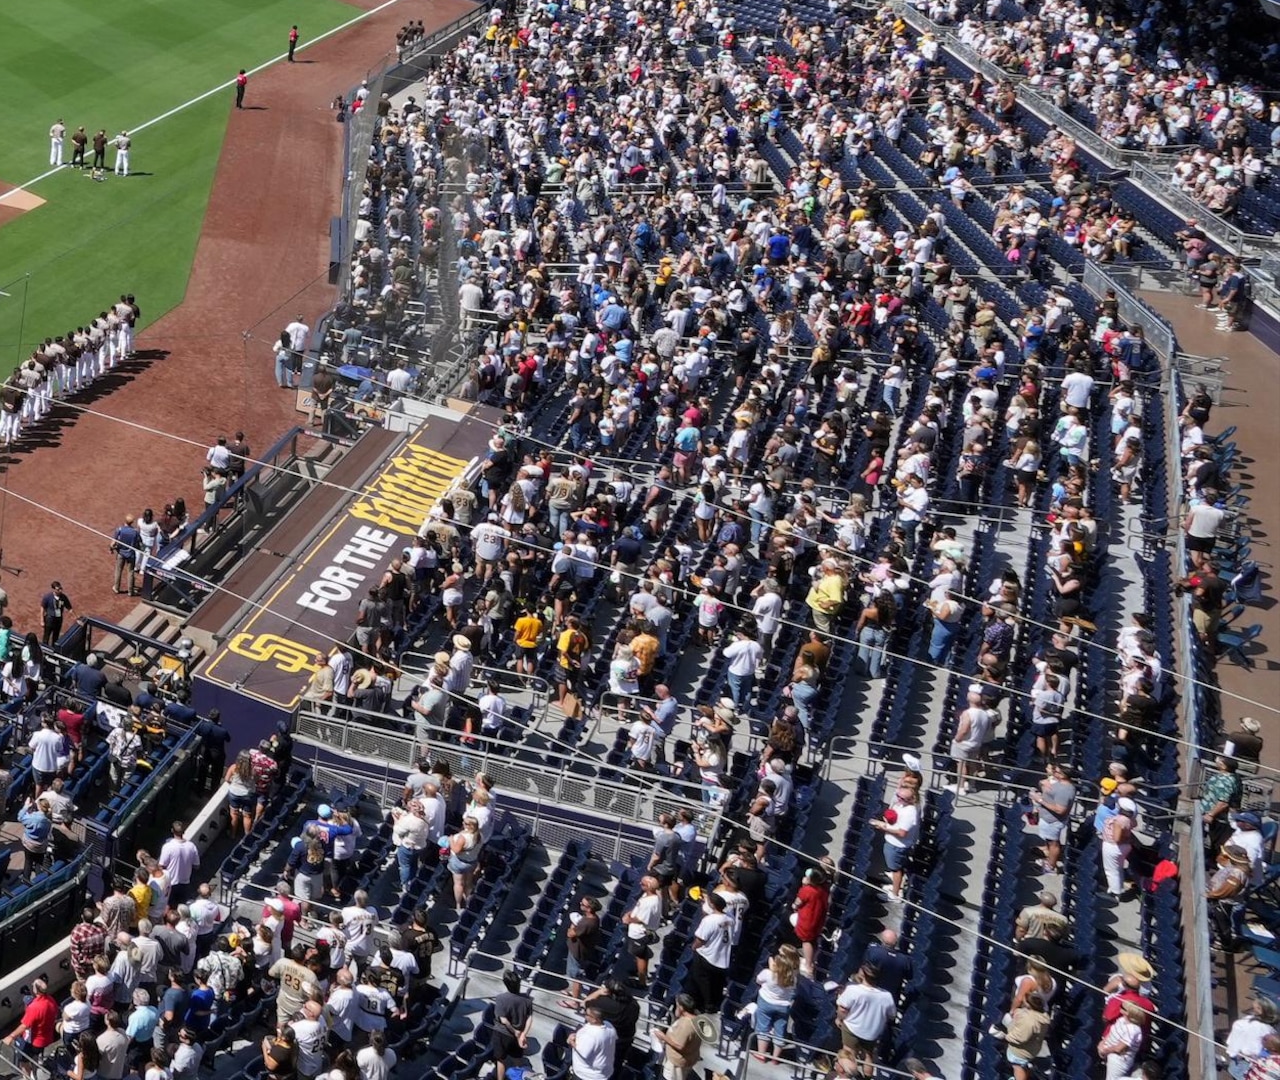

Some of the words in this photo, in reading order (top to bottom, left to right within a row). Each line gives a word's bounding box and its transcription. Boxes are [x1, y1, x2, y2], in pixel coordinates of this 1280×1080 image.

[456, 498, 468, 507] 23
[483, 534, 496, 544] 23
[296, 565, 366, 617] FOR
[341, 524, 398, 570] THE
[360, 923, 373, 936] 13
[284, 973, 301, 991] 23
[311, 1035, 327, 1054] 23
